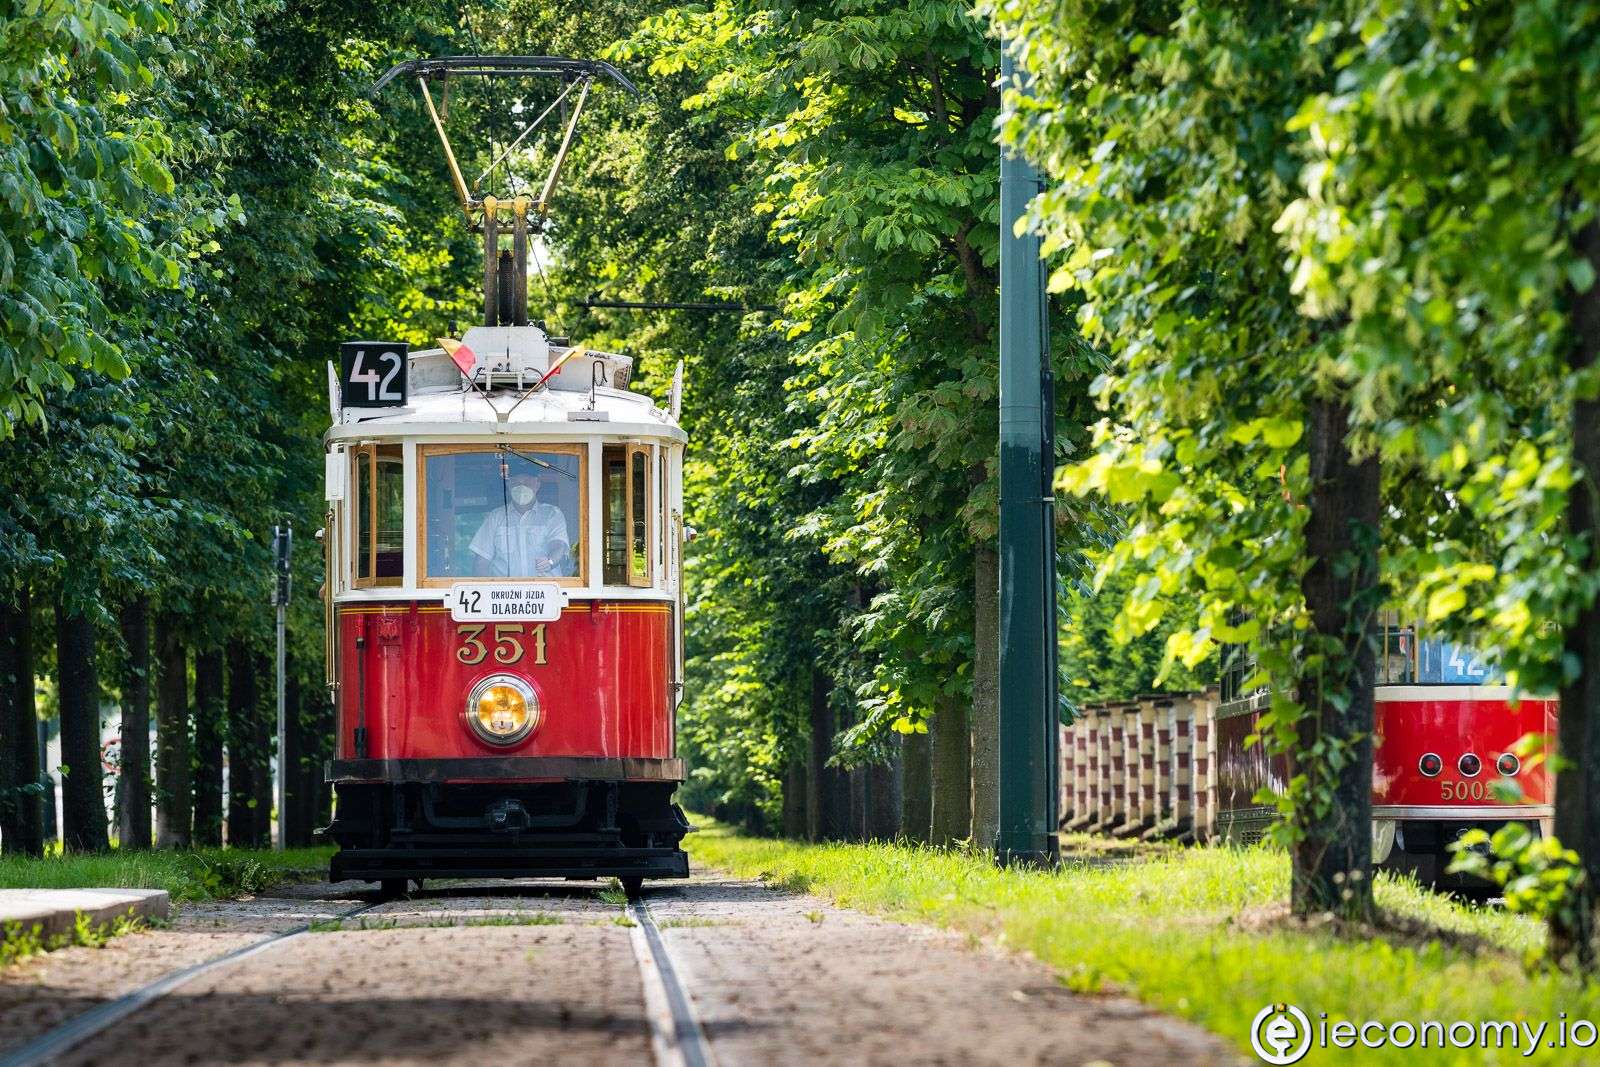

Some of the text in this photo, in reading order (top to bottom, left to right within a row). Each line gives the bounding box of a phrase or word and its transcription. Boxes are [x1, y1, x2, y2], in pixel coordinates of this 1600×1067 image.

[349, 351, 402, 400] 42
[459, 591, 481, 613] 42
[491, 590, 545, 599] OKRUŽNÍ JÍZDA
[491, 601, 545, 615] DLABAČOV
[457, 624, 547, 665] 351
